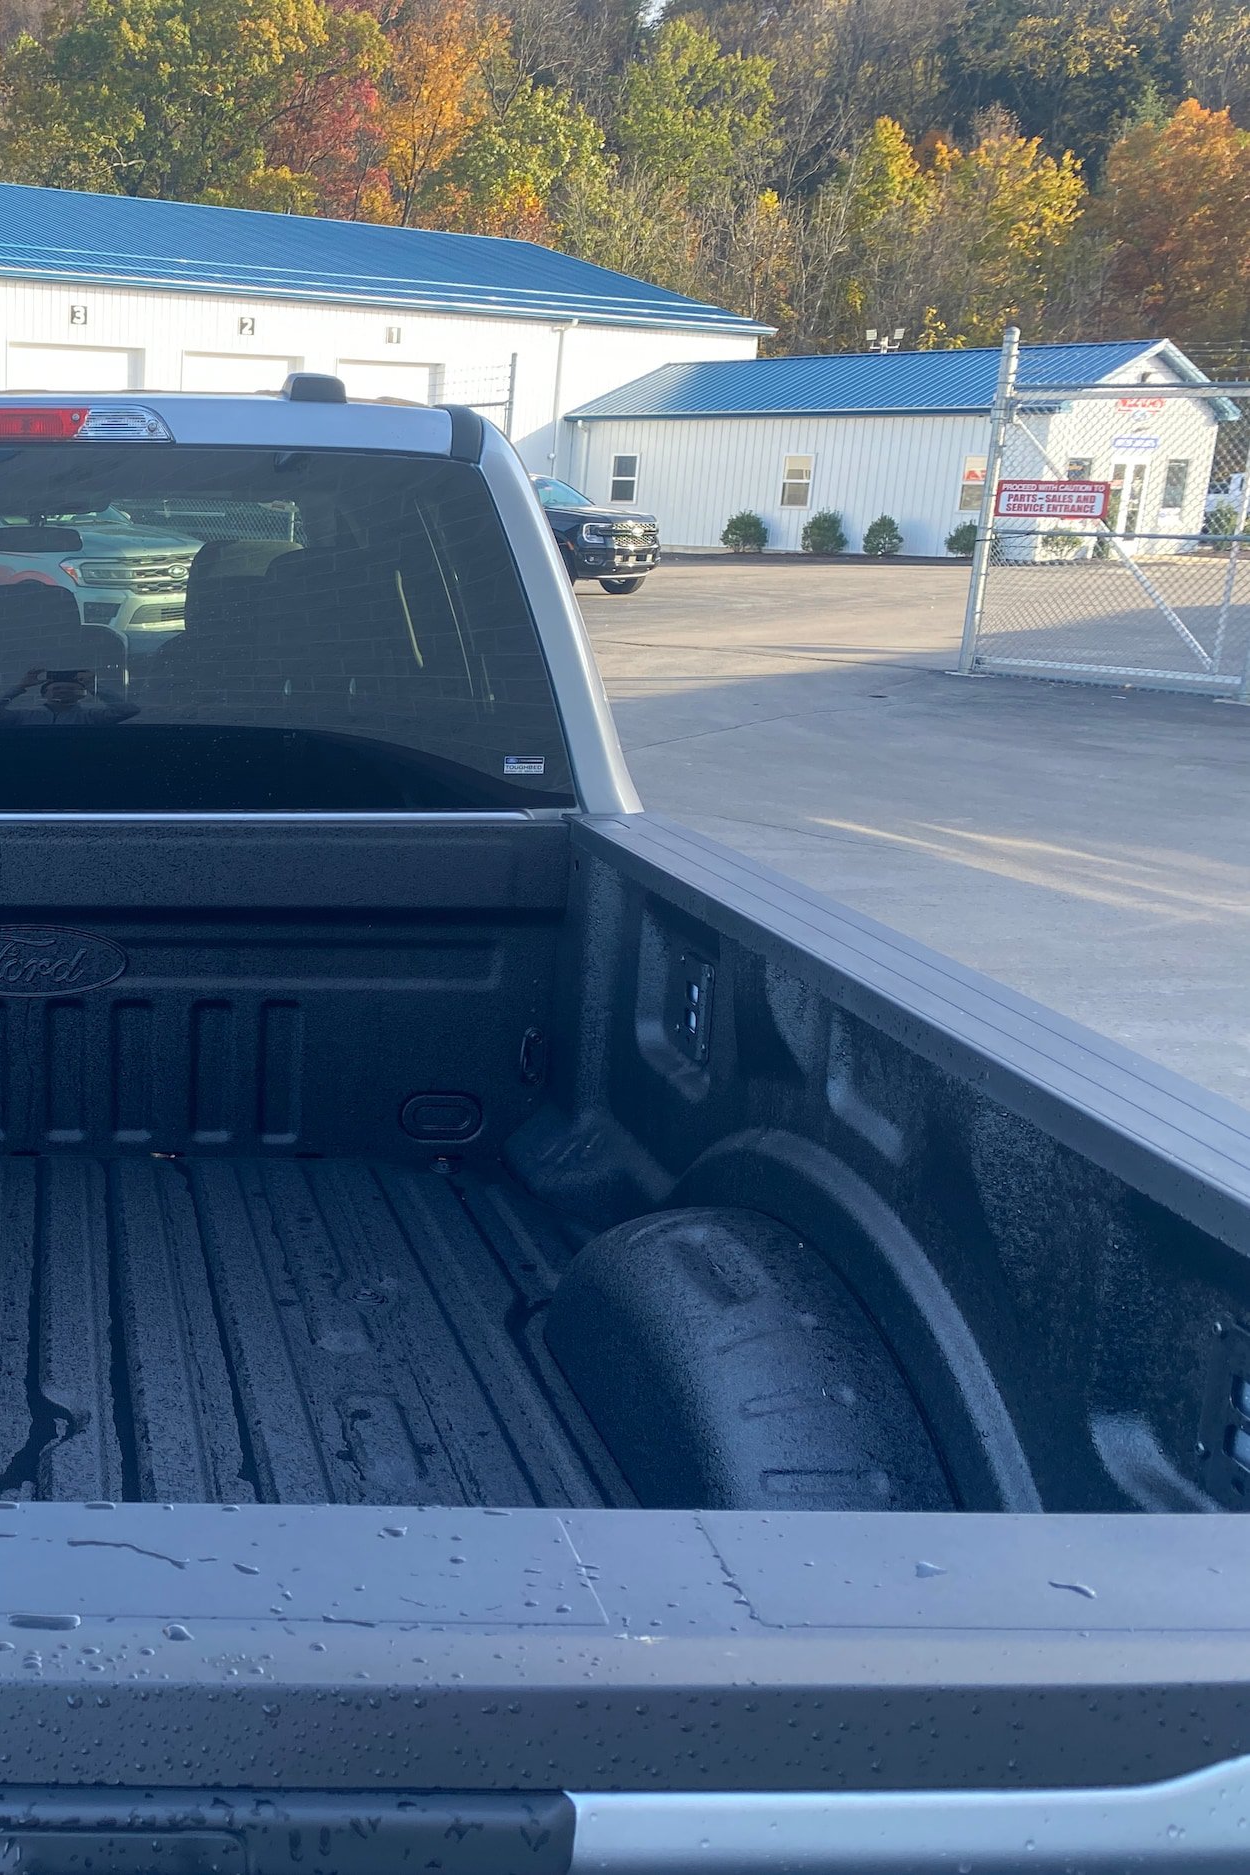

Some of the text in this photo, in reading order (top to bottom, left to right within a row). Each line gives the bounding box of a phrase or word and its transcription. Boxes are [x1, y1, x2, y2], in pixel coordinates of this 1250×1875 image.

[72, 305, 86, 324] 3
[241, 317, 253, 335] 2
[1002, 483, 1037, 491] PROCEED
[1058, 484, 1092, 492] CAUTION
[1075, 495, 1096, 504] AND
[1006, 503, 1095, 513] SERVICE ENTRANCE
